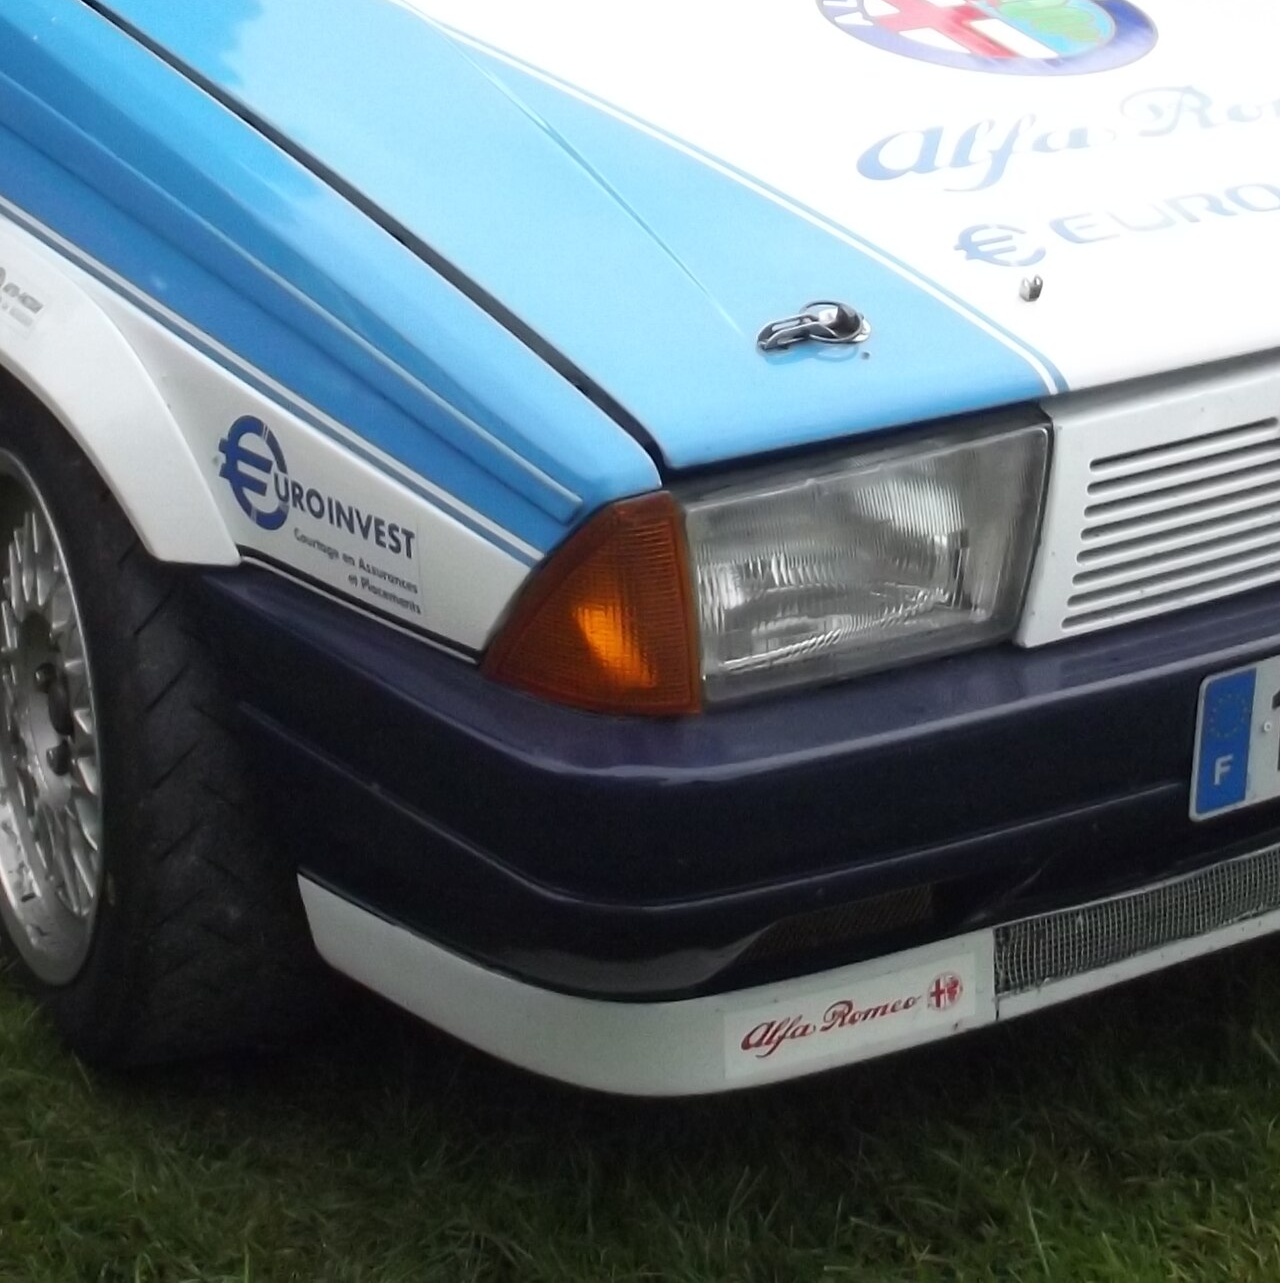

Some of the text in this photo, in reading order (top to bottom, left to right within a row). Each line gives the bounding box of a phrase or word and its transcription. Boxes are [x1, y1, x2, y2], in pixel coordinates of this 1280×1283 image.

[855, 112, 1118, 193] Alfa
[359, 557, 418, 594] Assurances
[1213, 754, 1232, 786] F
[741, 995, 923, 1058] Alfa Romeo
